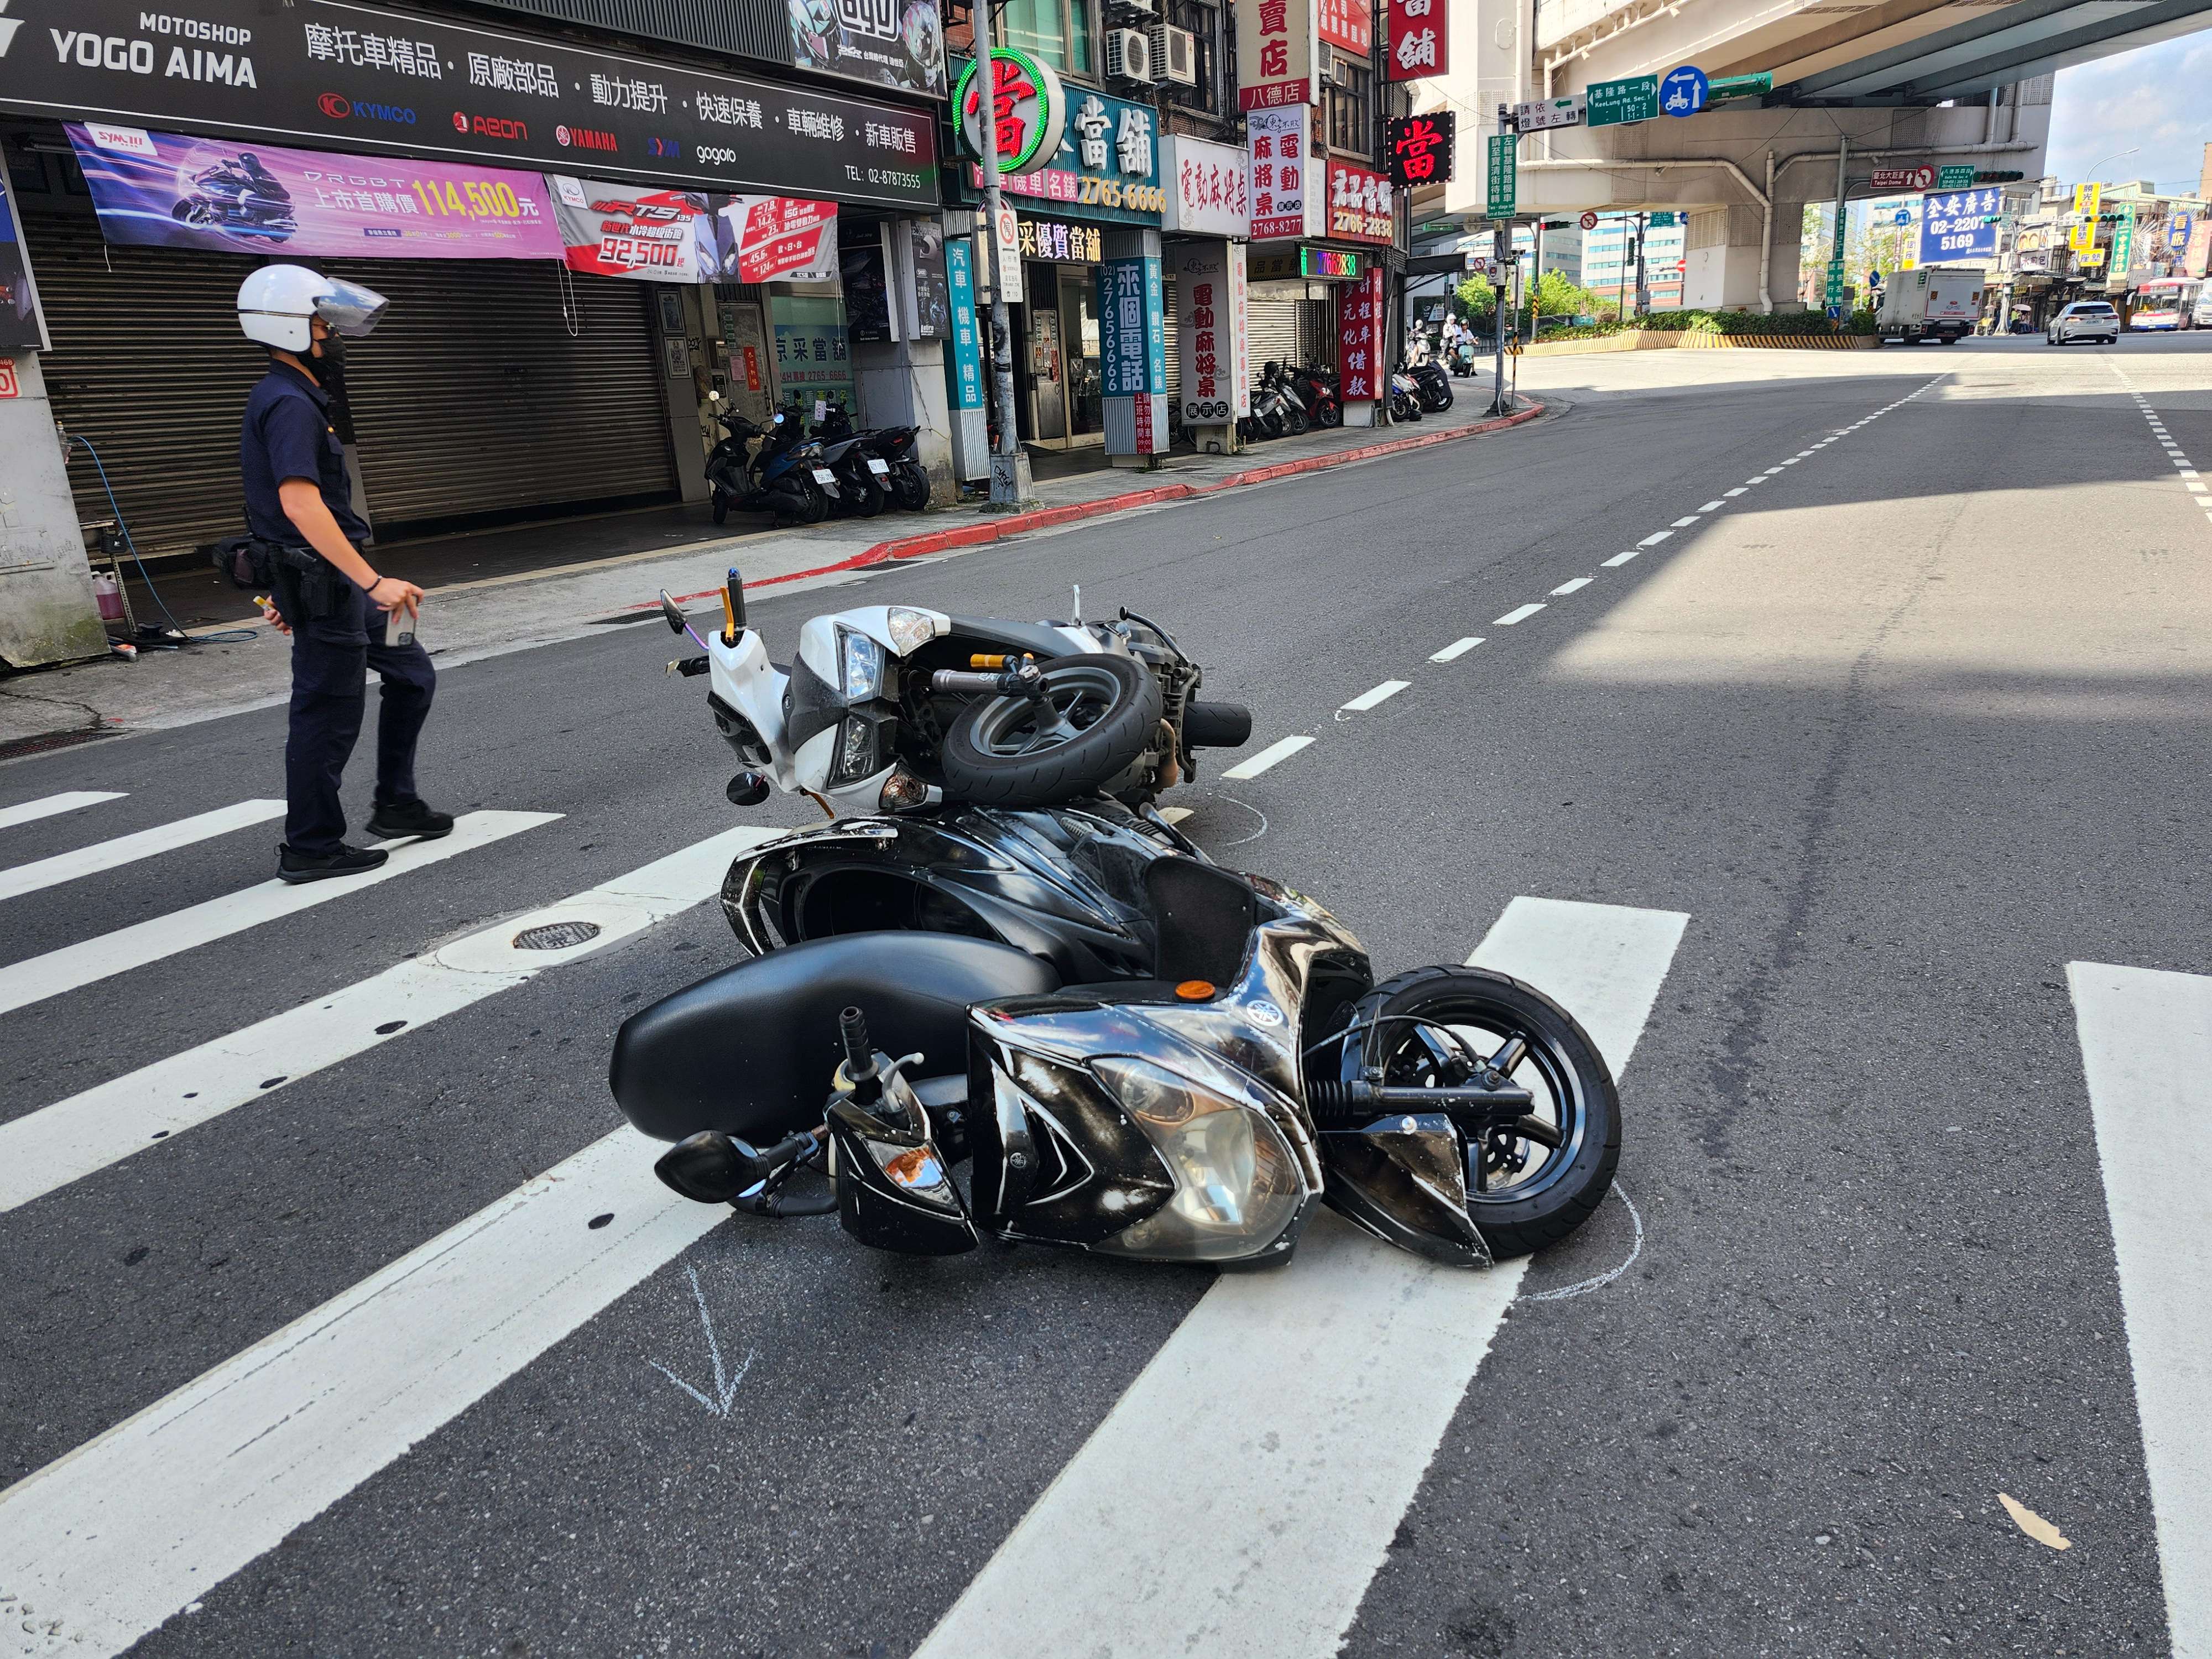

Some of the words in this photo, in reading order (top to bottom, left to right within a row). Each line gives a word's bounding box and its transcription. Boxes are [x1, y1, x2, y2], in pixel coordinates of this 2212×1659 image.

[140, 12, 251, 45] MOTOSHOP
[1260, 0, 1288, 78] 賣店
[49, 28, 154, 74] YOGO
[165, 46, 257, 88] AIMA
[304, 23, 442, 80] 摩托車精品
[468, 52, 559, 98] 原廠部品
[590, 74, 667, 114] 動力提升
[696, 90, 763, 129] 快速保養
[786, 107, 844, 142] 車輛維修
[865, 121, 916, 154] 新車販售
[1250, 83, 1300, 107] 八德店
[1595, 81, 1651, 99] 基隆路一段
[1595, 99, 1620, 108] KeeLung
[353, 101, 416, 124] KYMCO
[966, 60, 1036, 158] 當
[1520, 102, 1546, 115] 請依
[1521, 111, 1576, 128] 燈號左轉
[570, 128, 617, 152] YAMAHA
[1056, 96, 1152, 178] 當舖
[1396, 120, 1443, 179] 當
[697, 145, 736, 165] gogoro
[1280, 133, 1299, 191] 電動
[1503, 137, 1514, 202] 左轉基隆路機車
[304, 171, 405, 188] DRGBT
[845, 165, 864, 182] TEL:
[868, 168, 921, 189] 02-87873555
[1049, 173, 1076, 199] 名錶
[1181, 159, 1246, 217] 電動麻將桌
[1254, 135, 1273, 217] 麻將桌
[1873, 171, 1905, 180] 臺北大巨蛋
[315, 187, 419, 214] 上市首購價
[412, 180, 520, 221] 114,500
[564, 195, 584, 204] KYMCO
[1080, 176, 1167, 211] 2765-6666
[1277, 200, 1301, 211] 展示店
[1926, 191, 1996, 219] 全安廣告
[1252, 219, 1302, 236] 2768-8277
[1333, 211, 1392, 238] 2766-2838
[1940, 233, 1974, 250] 5169
[952, 247, 967, 288] 汽車
[1100, 265, 1115, 276] (02)
[1149, 263, 1158, 296] 黃金
[957, 305, 972, 346] 機車
[1343, 281, 1357, 345] 多元化
[1359, 275, 1371, 345] 計程車
[1103, 278, 1118, 392] 27656666
[1117, 264, 1144, 391] 來個電話
[1151, 311, 1160, 344] 鑽石
[1193, 283, 1216, 398] 電動麻將桌
[962, 363, 977, 404] 精品
[1154, 358, 1162, 389] 名錶
[1347, 349, 1369, 396] 借款
[1136, 393, 1144, 439] 上班時間
[1187, 402, 1228, 418] 展示店
